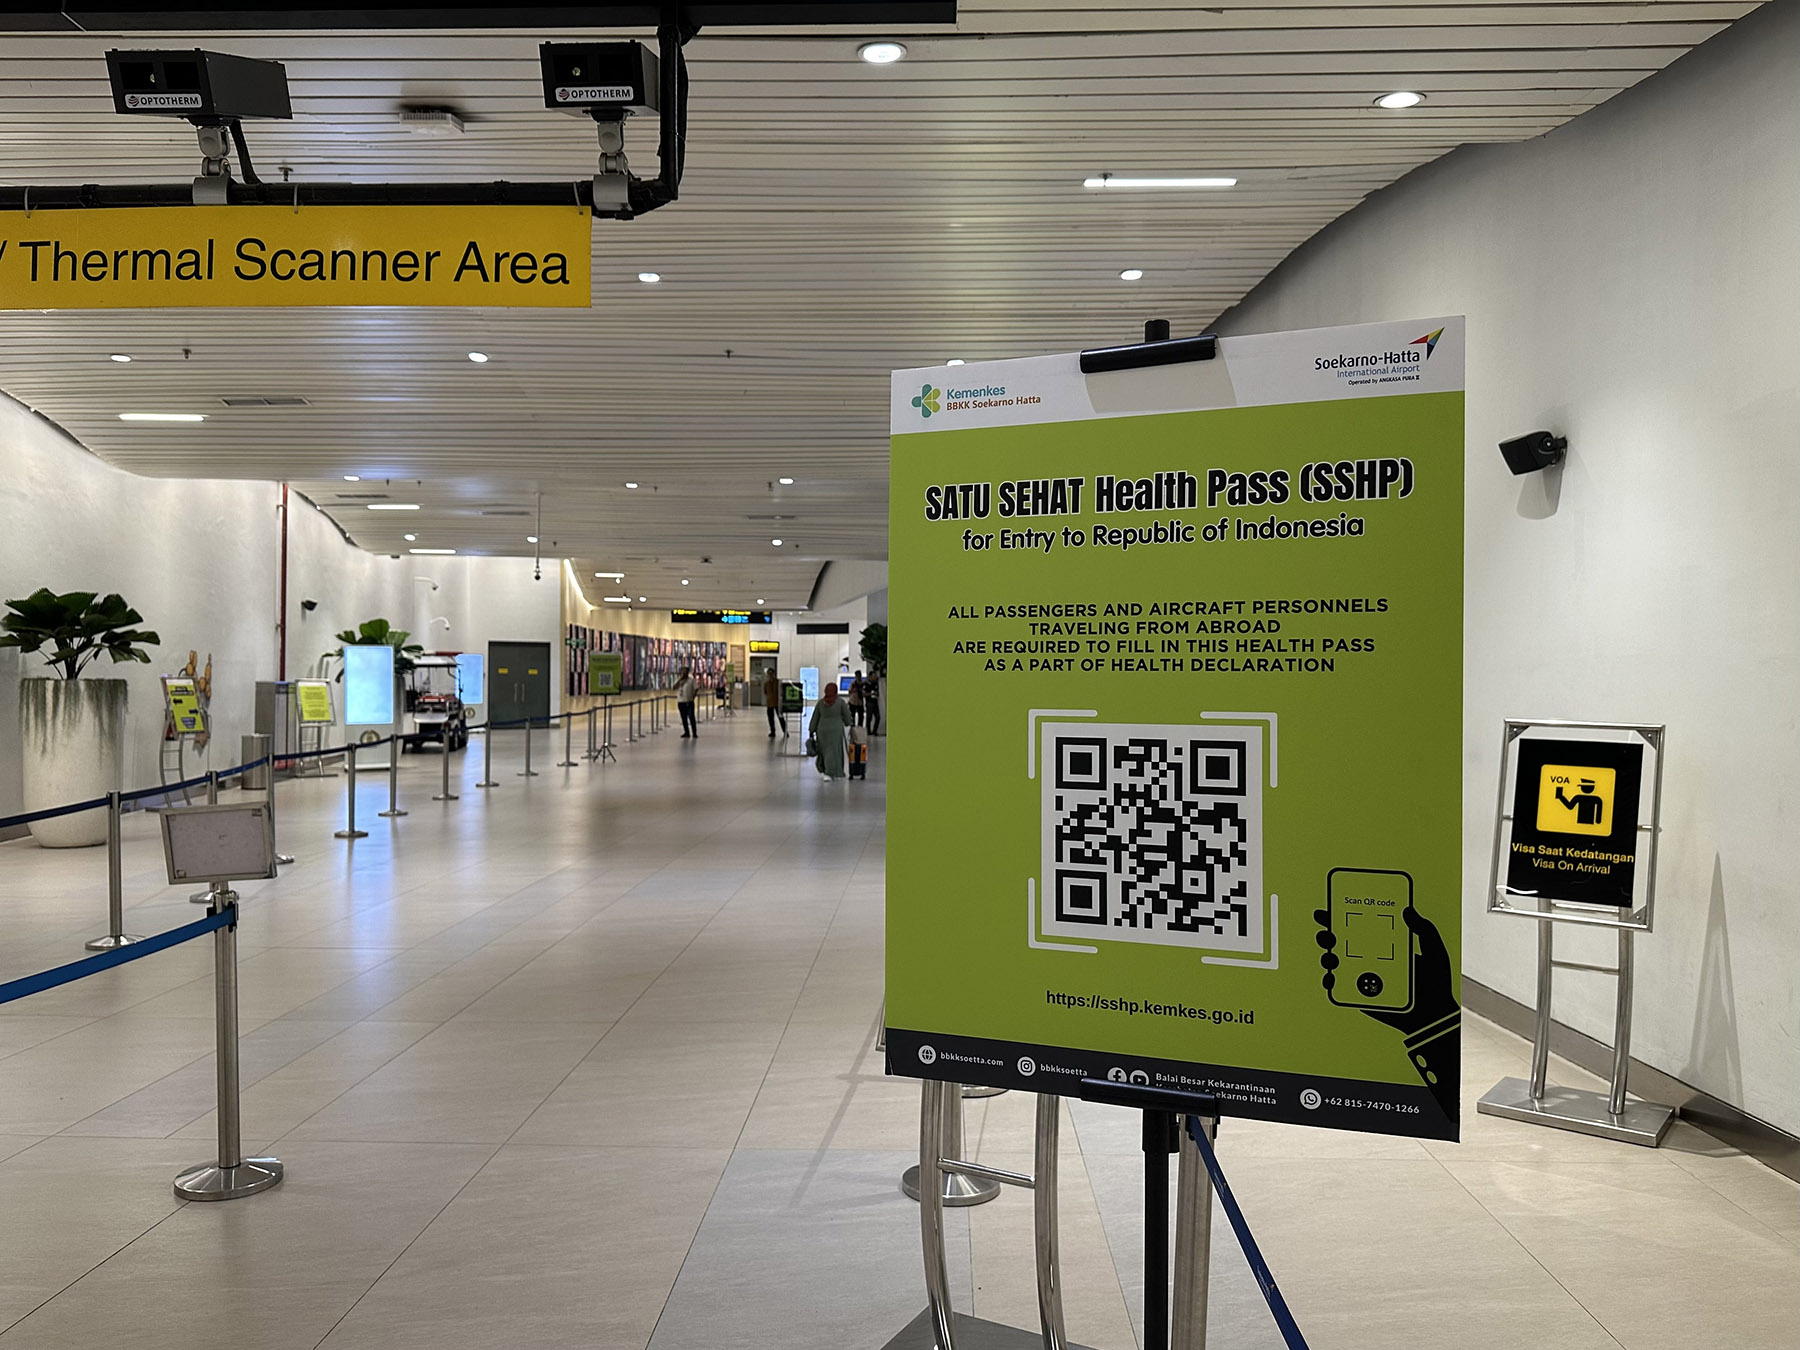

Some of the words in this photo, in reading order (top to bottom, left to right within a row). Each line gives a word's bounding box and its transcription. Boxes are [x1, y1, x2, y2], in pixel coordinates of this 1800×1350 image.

[140, 96, 200, 106] OPTOTHERM
[571, 89, 631, 99] OPTOTHERM
[18, 238, 214, 282] Thermal
[233, 237, 441, 282] Scanner
[453, 240, 570, 285] Area
[1314, 350, 1420, 370] Soekarno-Hatta
[1337, 368, 1389, 378] International
[1390, 364, 1420, 375] Airport
[946, 385, 1006, 400] Kemenkes
[946, 401, 970, 411] BBKK
[972, 399, 1014, 409] Soekarno
[1016, 396, 1041, 405] Hatta
[925, 483, 992, 521] SATU
[998, 477, 1085, 518] SEHAT
[1095, 471, 1198, 513] Health
[1206, 468, 1290, 508] Pass
[1299, 457, 1415, 503] (SSHP)
[962, 528, 995, 551] for
[1000, 527, 1056, 553] Entry
[1061, 526, 1086, 547] to
[1092, 519, 1196, 551] Republic
[1201, 517, 1229, 542] of
[1235, 512, 1365, 541] Indonesia
[948, 606, 979, 619] ALL
[984, 604, 1097, 618] PASSENGERS
[1103, 603, 1143, 616] AND
[1149, 601, 1246, 616] AIRCRAFT
[1252, 598, 1389, 614] PERSONNELS
[1029, 622, 1130, 635] TRAVELING
[1136, 620, 1190, 634] FROM
[1195, 619, 1281, 634] ABROAD
[953, 641, 986, 654] ARE
[992, 640, 1080, 654] REQUIRED
[1086, 640, 1111, 653] TO
[1117, 640, 1155, 653] FILL
[1161, 639, 1180, 653] IN
[1186, 639, 1229, 653] THIS
[1235, 638, 1315, 652] HEALTH
[1322, 638, 1375, 652] PASS
[984, 659, 1006, 671] AS
[1011, 659, 1024, 671] A
[1030, 659, 1075, 671] PART
[1080, 658, 1105, 671] OF
[1111, 658, 1184, 672] HEALTH
[1191, 657, 1335, 672] DECLARATION
[1550, 775, 1570, 784] VOA
[1512, 842, 1535, 854] Visa
[1538, 845, 1563, 857] Saat
[1566, 848, 1634, 864] Kedatangan
[1532, 858, 1555, 870] Visa
[1558, 860, 1574, 872] On
[1576, 862, 1611, 875] Arrival
[1344, 896, 1362, 905] Scan
[1364, 897, 1376, 906] QR
[1377, 898, 1396, 907] code
[1046, 990, 1255, 1025] https://sshp.kemkes.go.id
[940, 1051, 1004, 1067] bbkksoetta.com
[1040, 1063, 1088, 1077] bbkksoetta
[1156, 1073, 1178, 1083] Balai
[1180, 1075, 1206, 1086] Besar
[1207, 1079, 1276, 1094] Kekarantinaan
[1205, 1089, 1248, 1102] ekarno
[1249, 1094, 1277, 1105] Hatta
[1324, 1097, 1342, 1106] +62
[1344, 1098, 1420, 1114] 815-7470-1266
